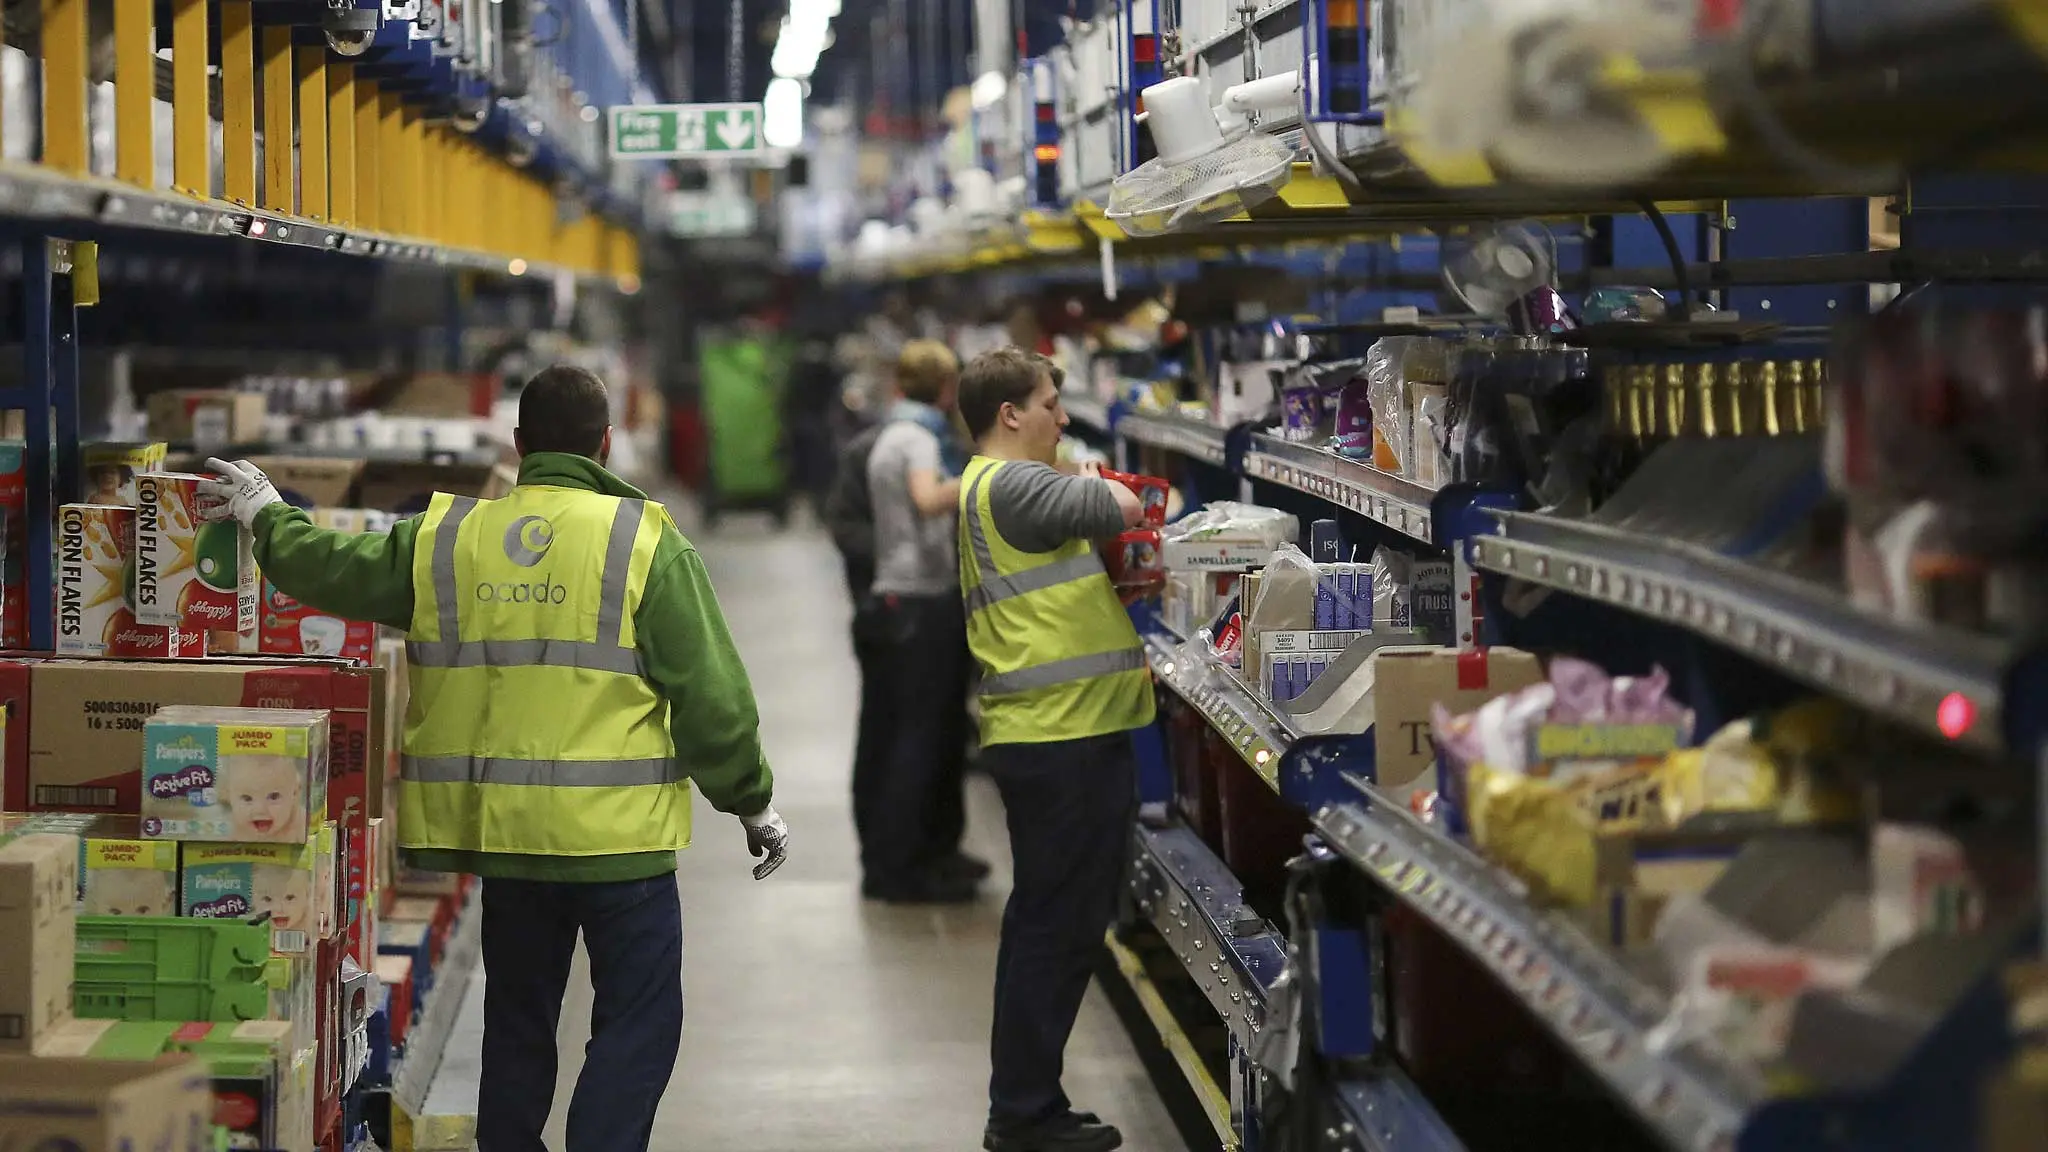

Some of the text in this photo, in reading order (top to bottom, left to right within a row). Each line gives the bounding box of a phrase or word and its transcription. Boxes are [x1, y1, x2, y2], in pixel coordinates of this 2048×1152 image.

[620, 113, 662, 131] Fire
[621, 133, 660, 149] exit
[139, 479, 157, 532] CORN
[63, 510, 82, 562] CORN
[139, 536, 157, 605] FLAKES
[477, 572, 566, 604] ocado
[61, 567, 82, 635] FLAKES
[188, 600, 234, 620] Kellogg's
[116, 629, 164, 648] Kellogg's
[87, 717, 102, 730] 16
[232, 732, 273, 740] JUMBO
[235, 740, 268, 748] PACK
[156, 743, 206, 763] Pampers
[146, 820, 155, 832] 3
[100, 844, 142, 853] JUMBO
[104, 853, 136, 862] PACK
[199, 848, 276, 858] JUMBO PACK
[195, 874, 241, 893] Pampers
